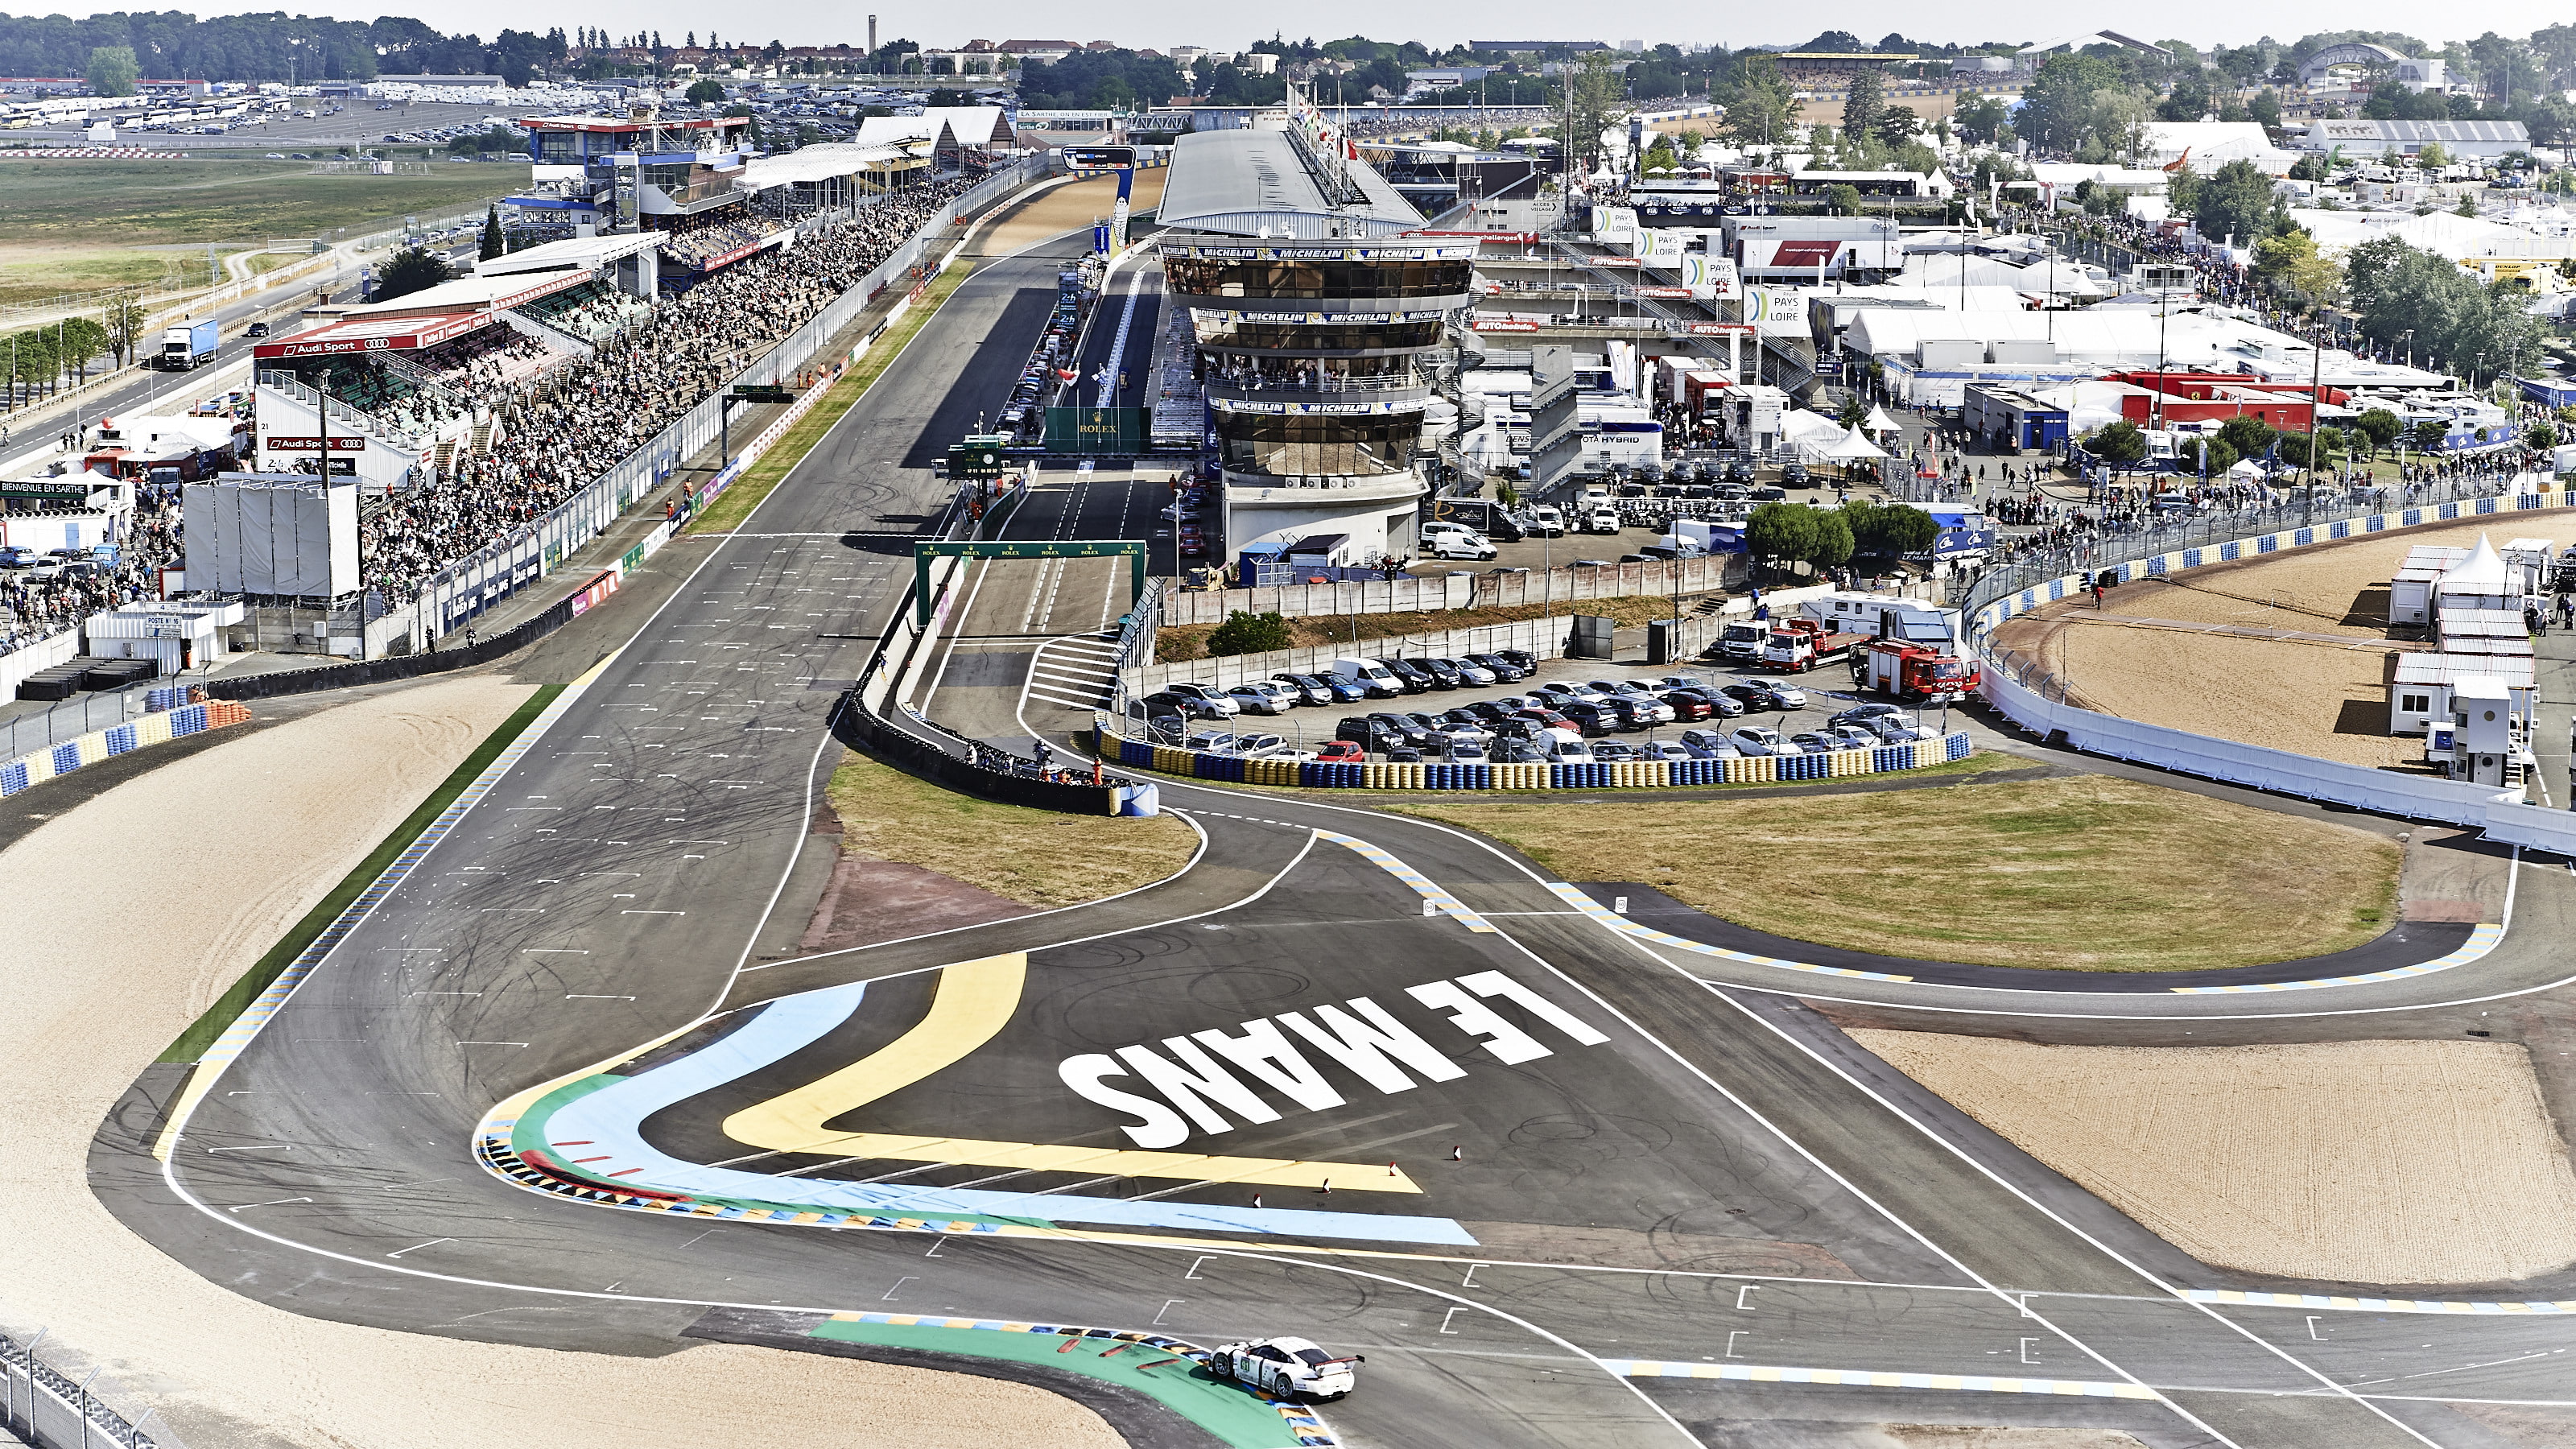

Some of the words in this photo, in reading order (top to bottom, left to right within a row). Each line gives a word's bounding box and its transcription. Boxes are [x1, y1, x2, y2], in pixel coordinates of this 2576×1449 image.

[1658, 236, 1678, 244] PAYS
[1203, 248, 1256, 257] MICHELIN
[1280, 249, 1343, 258] MICHELIN
[1367, 249, 1424, 258] MICHELIN
[1710, 264, 1732, 272] PAYS
[1774, 297, 1798, 306] PAYS
[1246, 312, 1306, 321] MICHELIN
[1330, 313, 1389, 321] MICHELIN
[1408, 310, 1442, 320] MICHELIN
[1770, 312, 1798, 321] LOIRE
[297, 343, 322, 353] Audi
[324, 342, 355, 353] Sport
[1232, 401, 1283, 411] MICHELIN
[1309, 403, 1371, 411] MICHELIN
[1080, 424, 1117, 434] ROLEX
[305, 440, 333, 449] Spot
[2, 483, 42, 493] BIENVENUE
[44, 485, 55, 493] EN
[56, 485, 85, 494] SARTHE
[1404, 969, 1612, 1066] LE
[1058, 996, 1469, 1150] MANS
